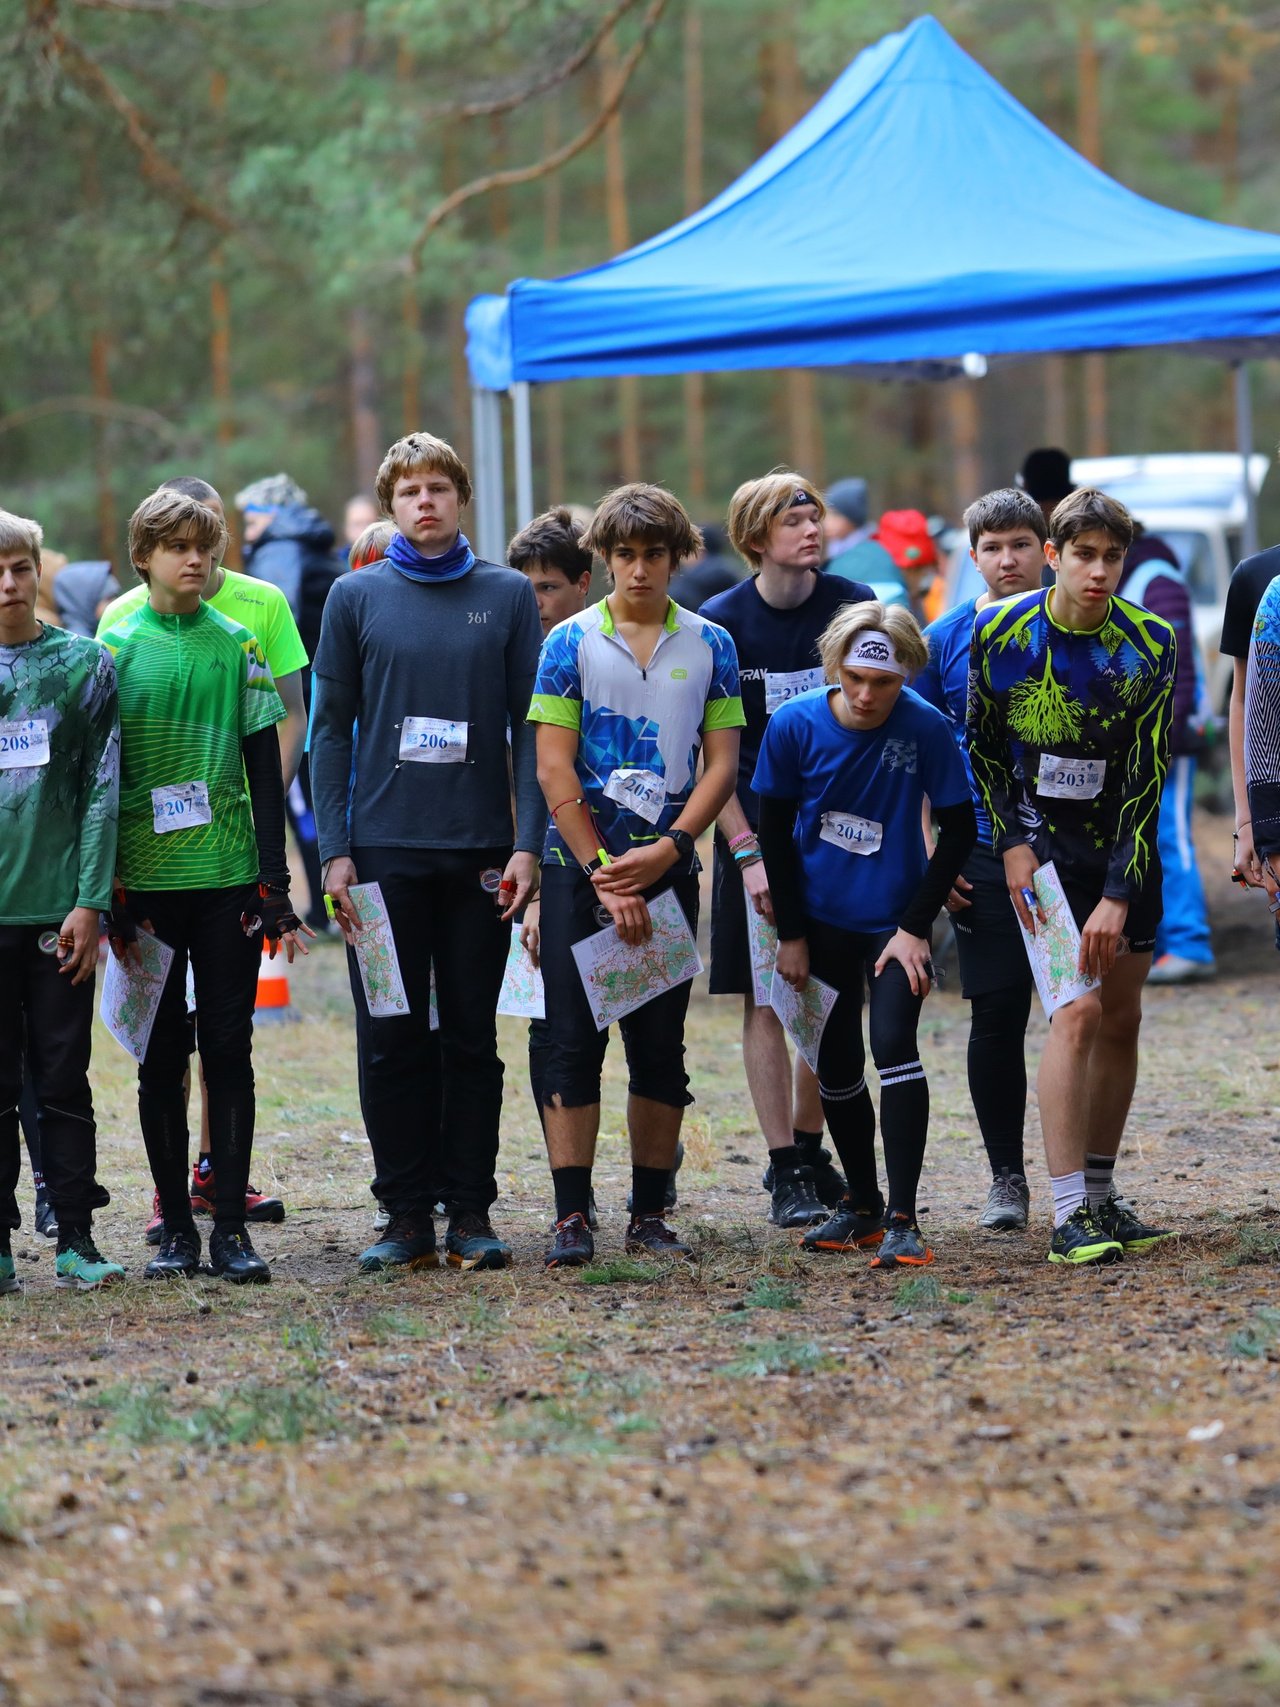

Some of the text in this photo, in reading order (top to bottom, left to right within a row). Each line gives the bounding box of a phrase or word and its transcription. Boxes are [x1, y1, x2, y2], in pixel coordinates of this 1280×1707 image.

[0, 735, 30, 752] 208
[419, 733, 449, 749] 206
[1056, 771, 1086, 787] 203
[624, 778, 654, 802] 205
[165, 797, 193, 816] 207
[836, 823, 863, 842] 204
